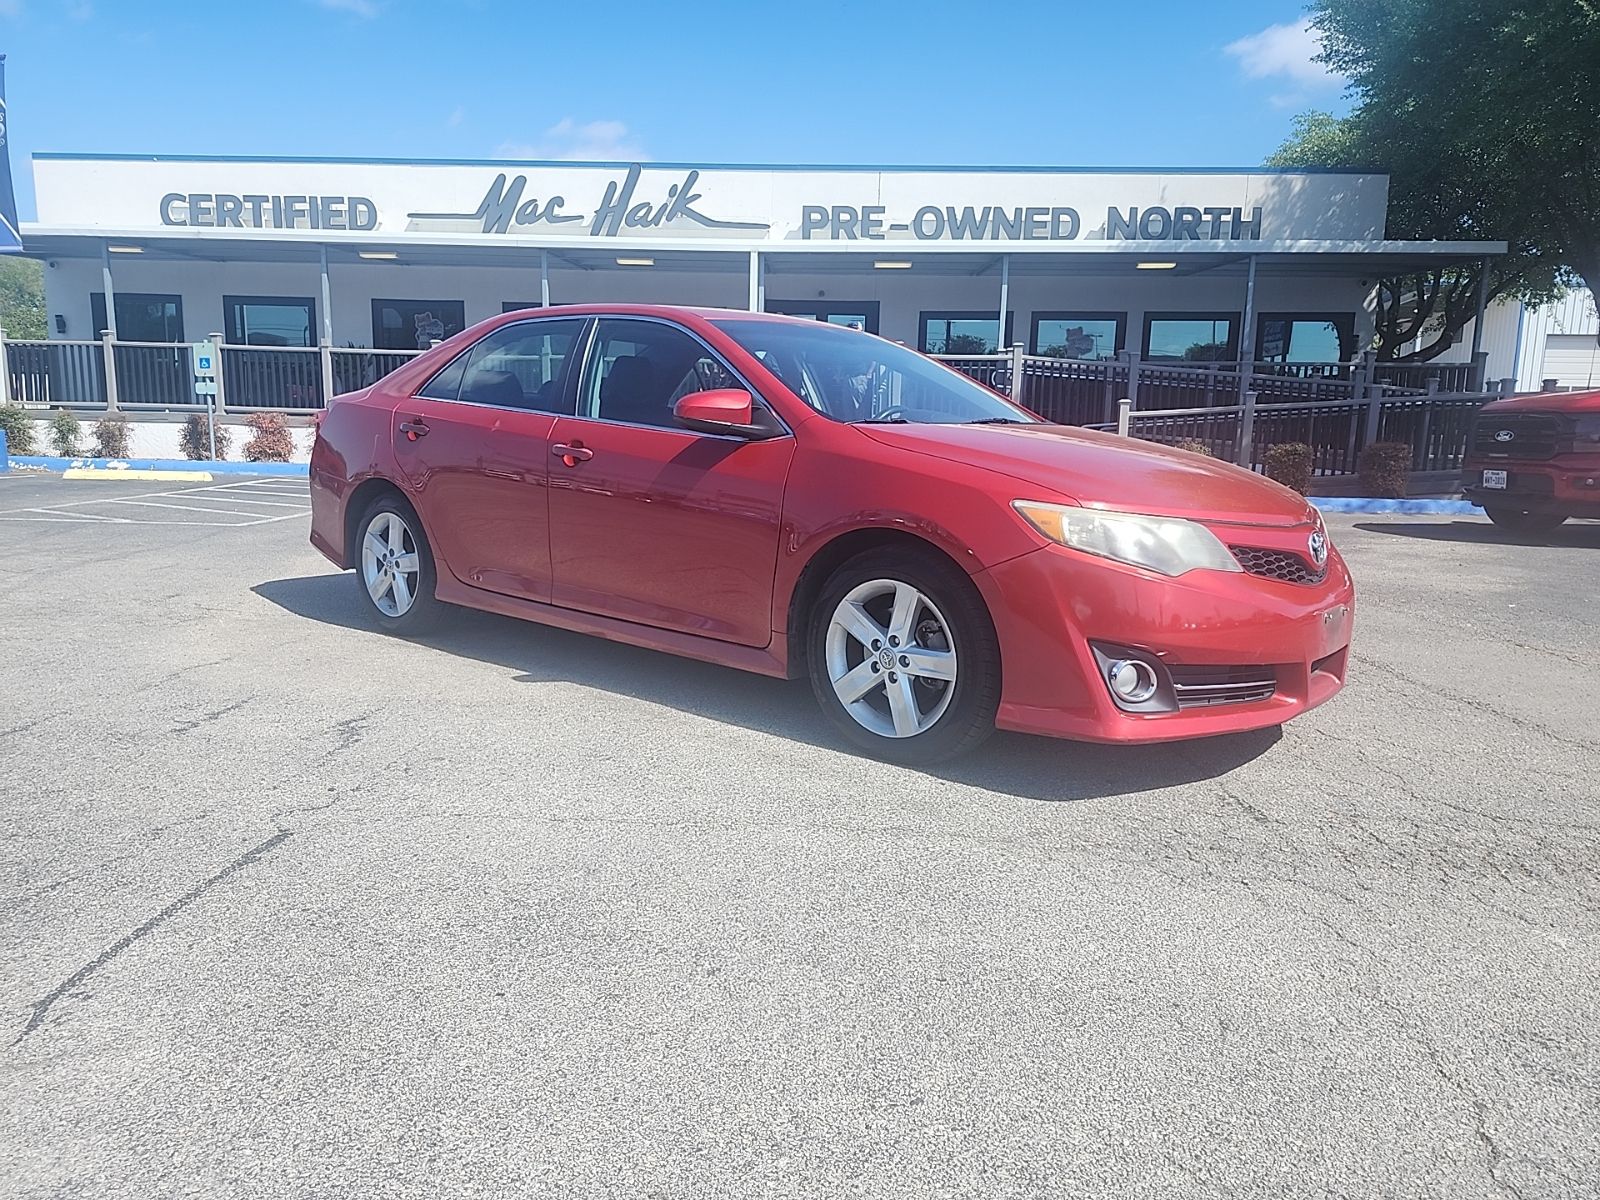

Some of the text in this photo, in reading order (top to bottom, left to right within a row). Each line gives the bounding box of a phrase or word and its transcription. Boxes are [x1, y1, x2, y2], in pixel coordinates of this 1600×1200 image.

[159, 162, 1263, 241] CERTIFIED Mac Haik PRE-OWNED NORTH
